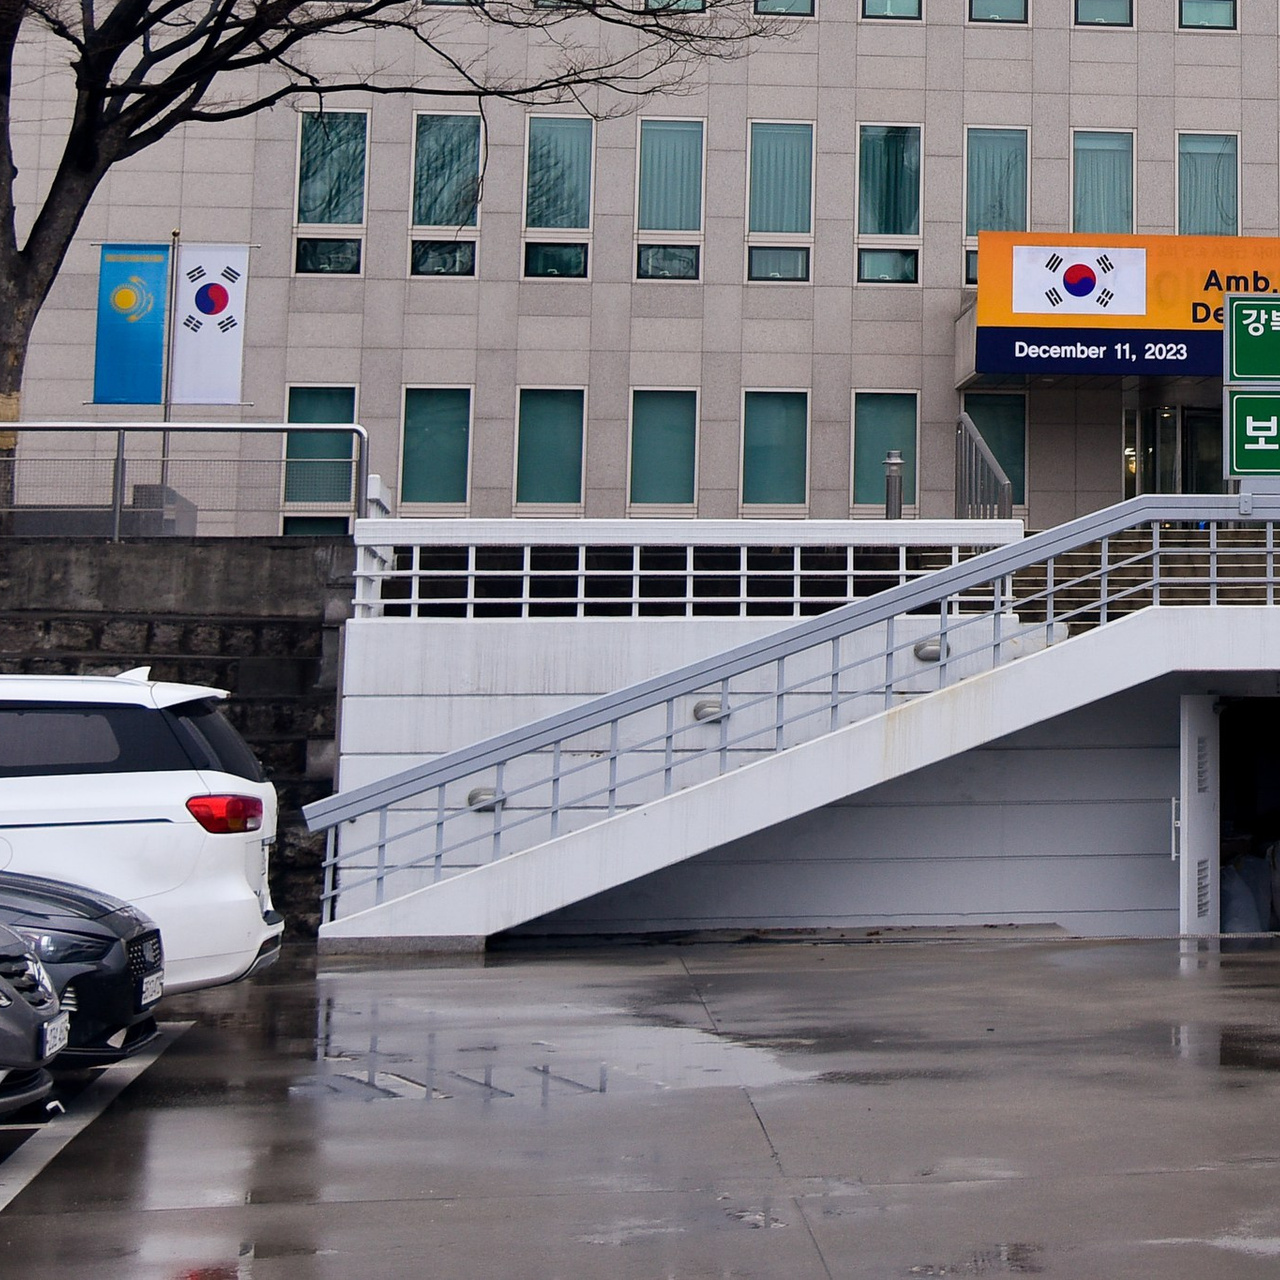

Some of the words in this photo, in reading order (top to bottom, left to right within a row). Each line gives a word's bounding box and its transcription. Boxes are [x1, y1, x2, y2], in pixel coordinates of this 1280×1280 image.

[1203, 269, 1278, 294] Amb.
[1014, 341, 1107, 359] December
[1114, 342, 1137, 362] 11,
[1143, 343, 1188, 361] 2023
